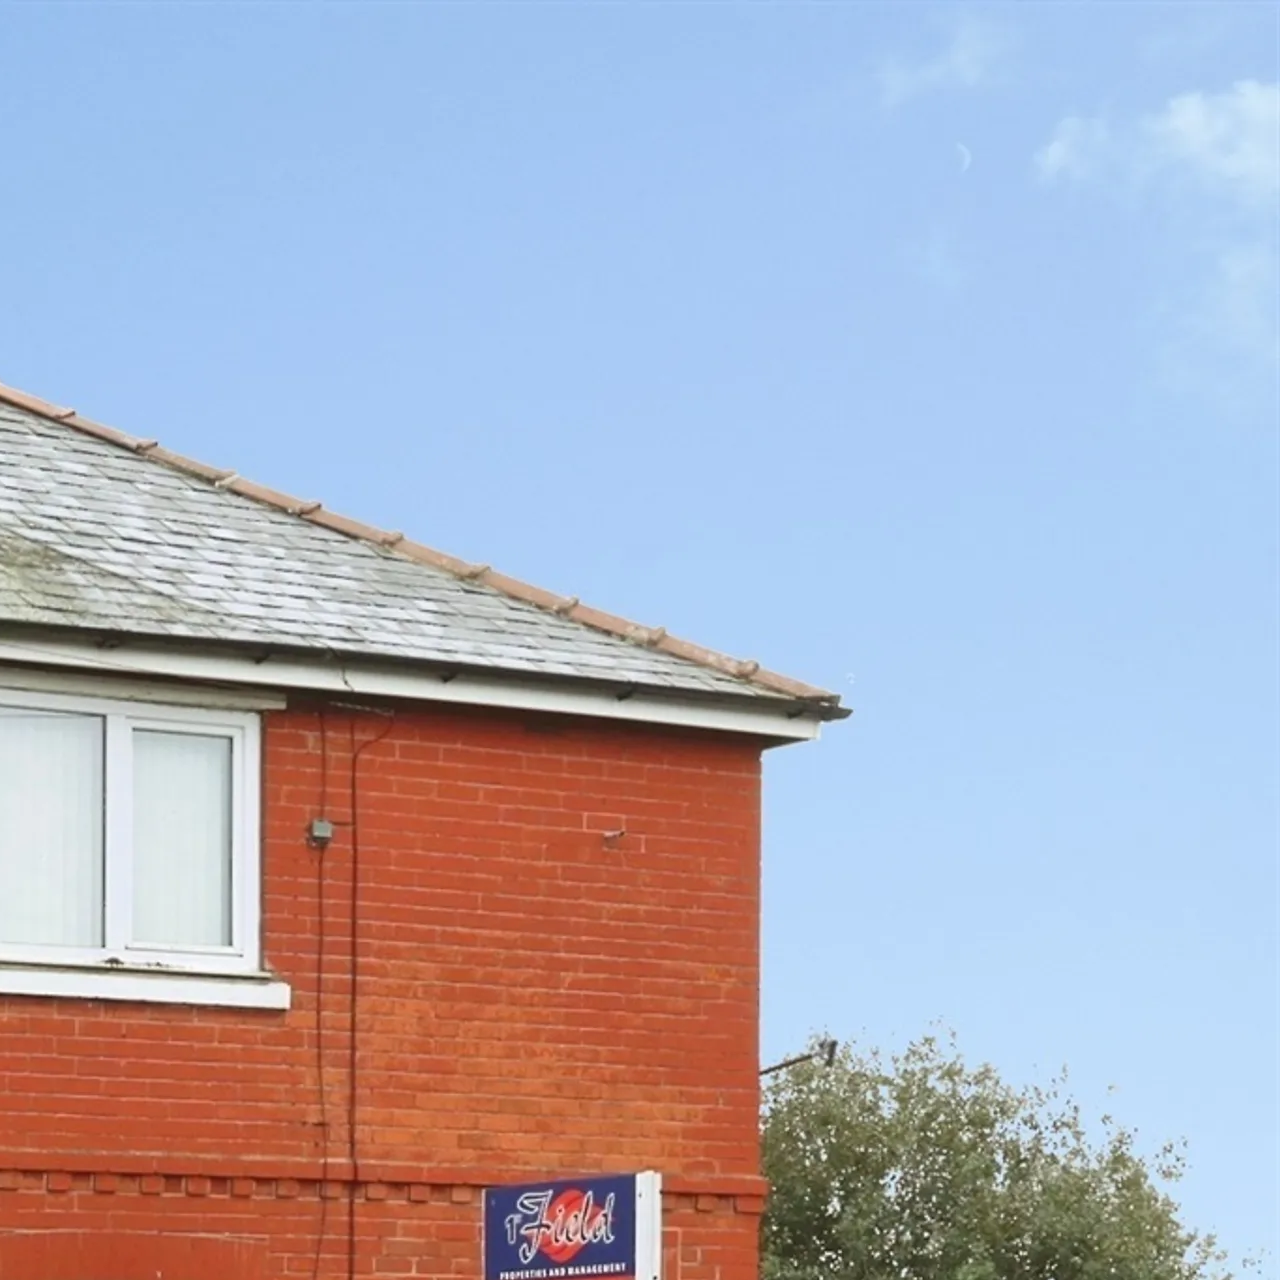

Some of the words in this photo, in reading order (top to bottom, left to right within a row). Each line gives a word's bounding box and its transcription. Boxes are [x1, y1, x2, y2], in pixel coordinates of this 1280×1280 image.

[517, 1189, 615, 1264] Field
[549, 1266, 566, 1277] AND
[568, 1262, 626, 1275] MANAGEMENT
